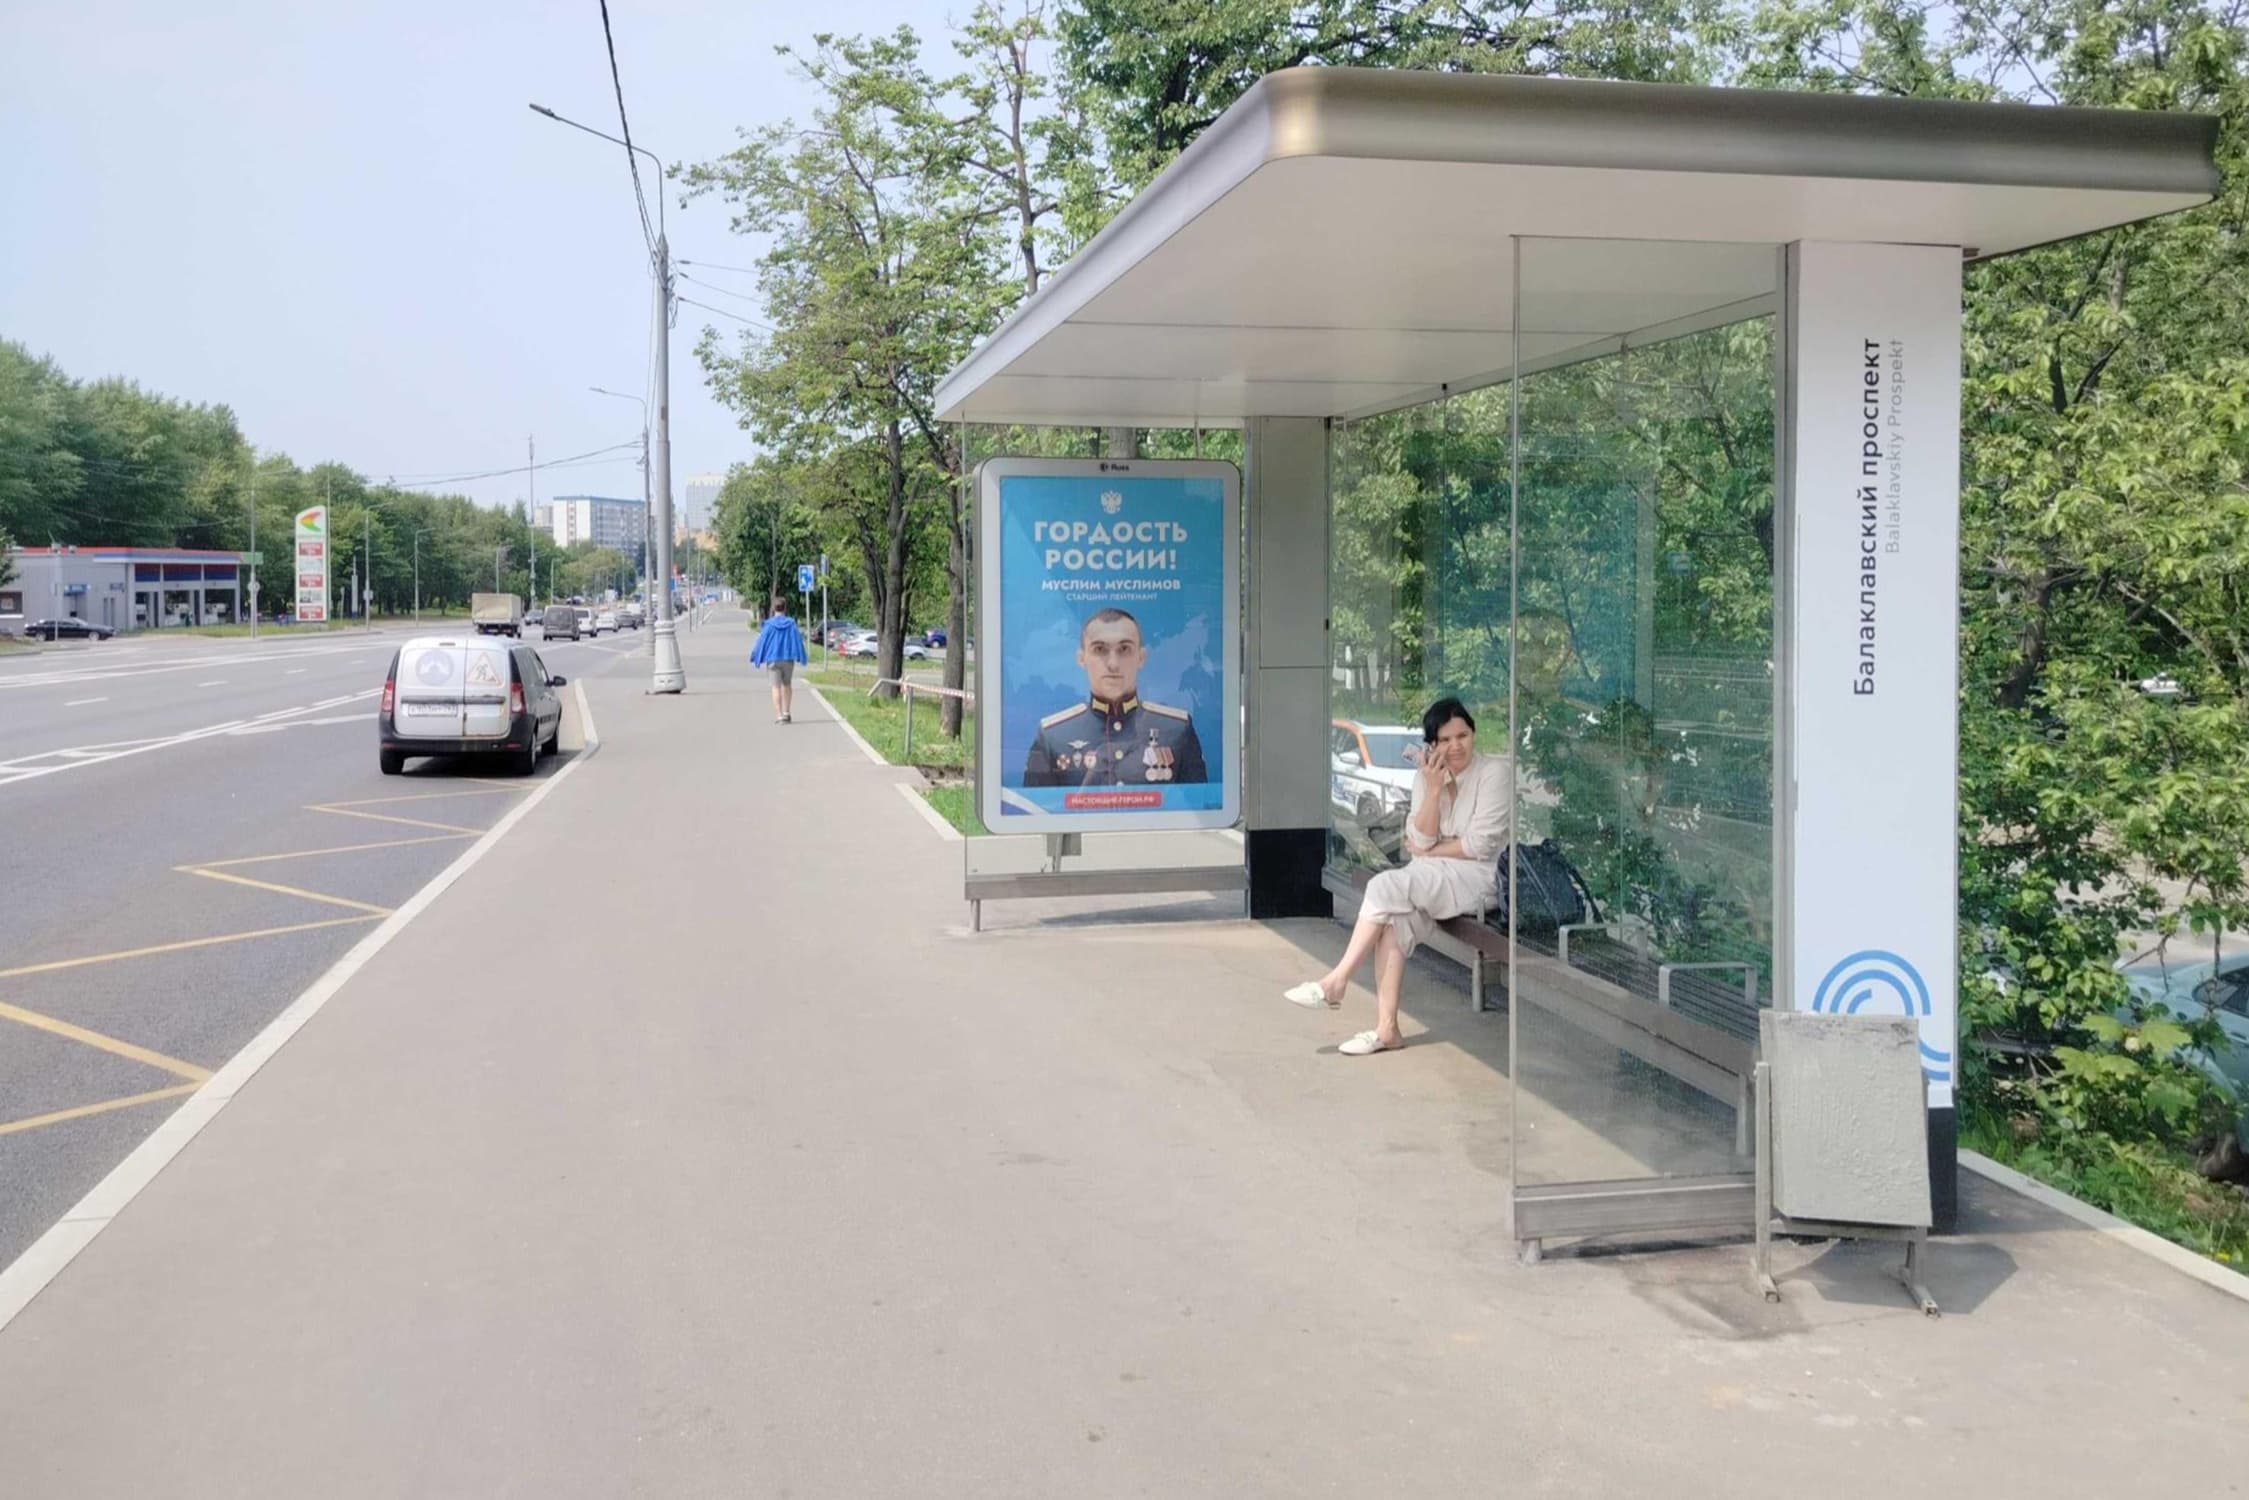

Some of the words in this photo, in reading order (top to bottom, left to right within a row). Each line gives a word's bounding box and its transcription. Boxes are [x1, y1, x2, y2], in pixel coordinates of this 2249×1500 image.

[1861, 338, 1883, 477] проспект
[1887, 340, 1906, 427] Prospekt
[1034, 521, 1188, 545] ГОРДОСТЬ
[1885, 431, 1904, 554] Balaklavskiy
[1041, 579, 1100, 591] МУСЛИМ
[1104, 579, 1181, 590] МУСЛИМОВ
[1045, 549, 1177, 570] РОССИИ!
[1853, 485, 1878, 696] Балаклавский
